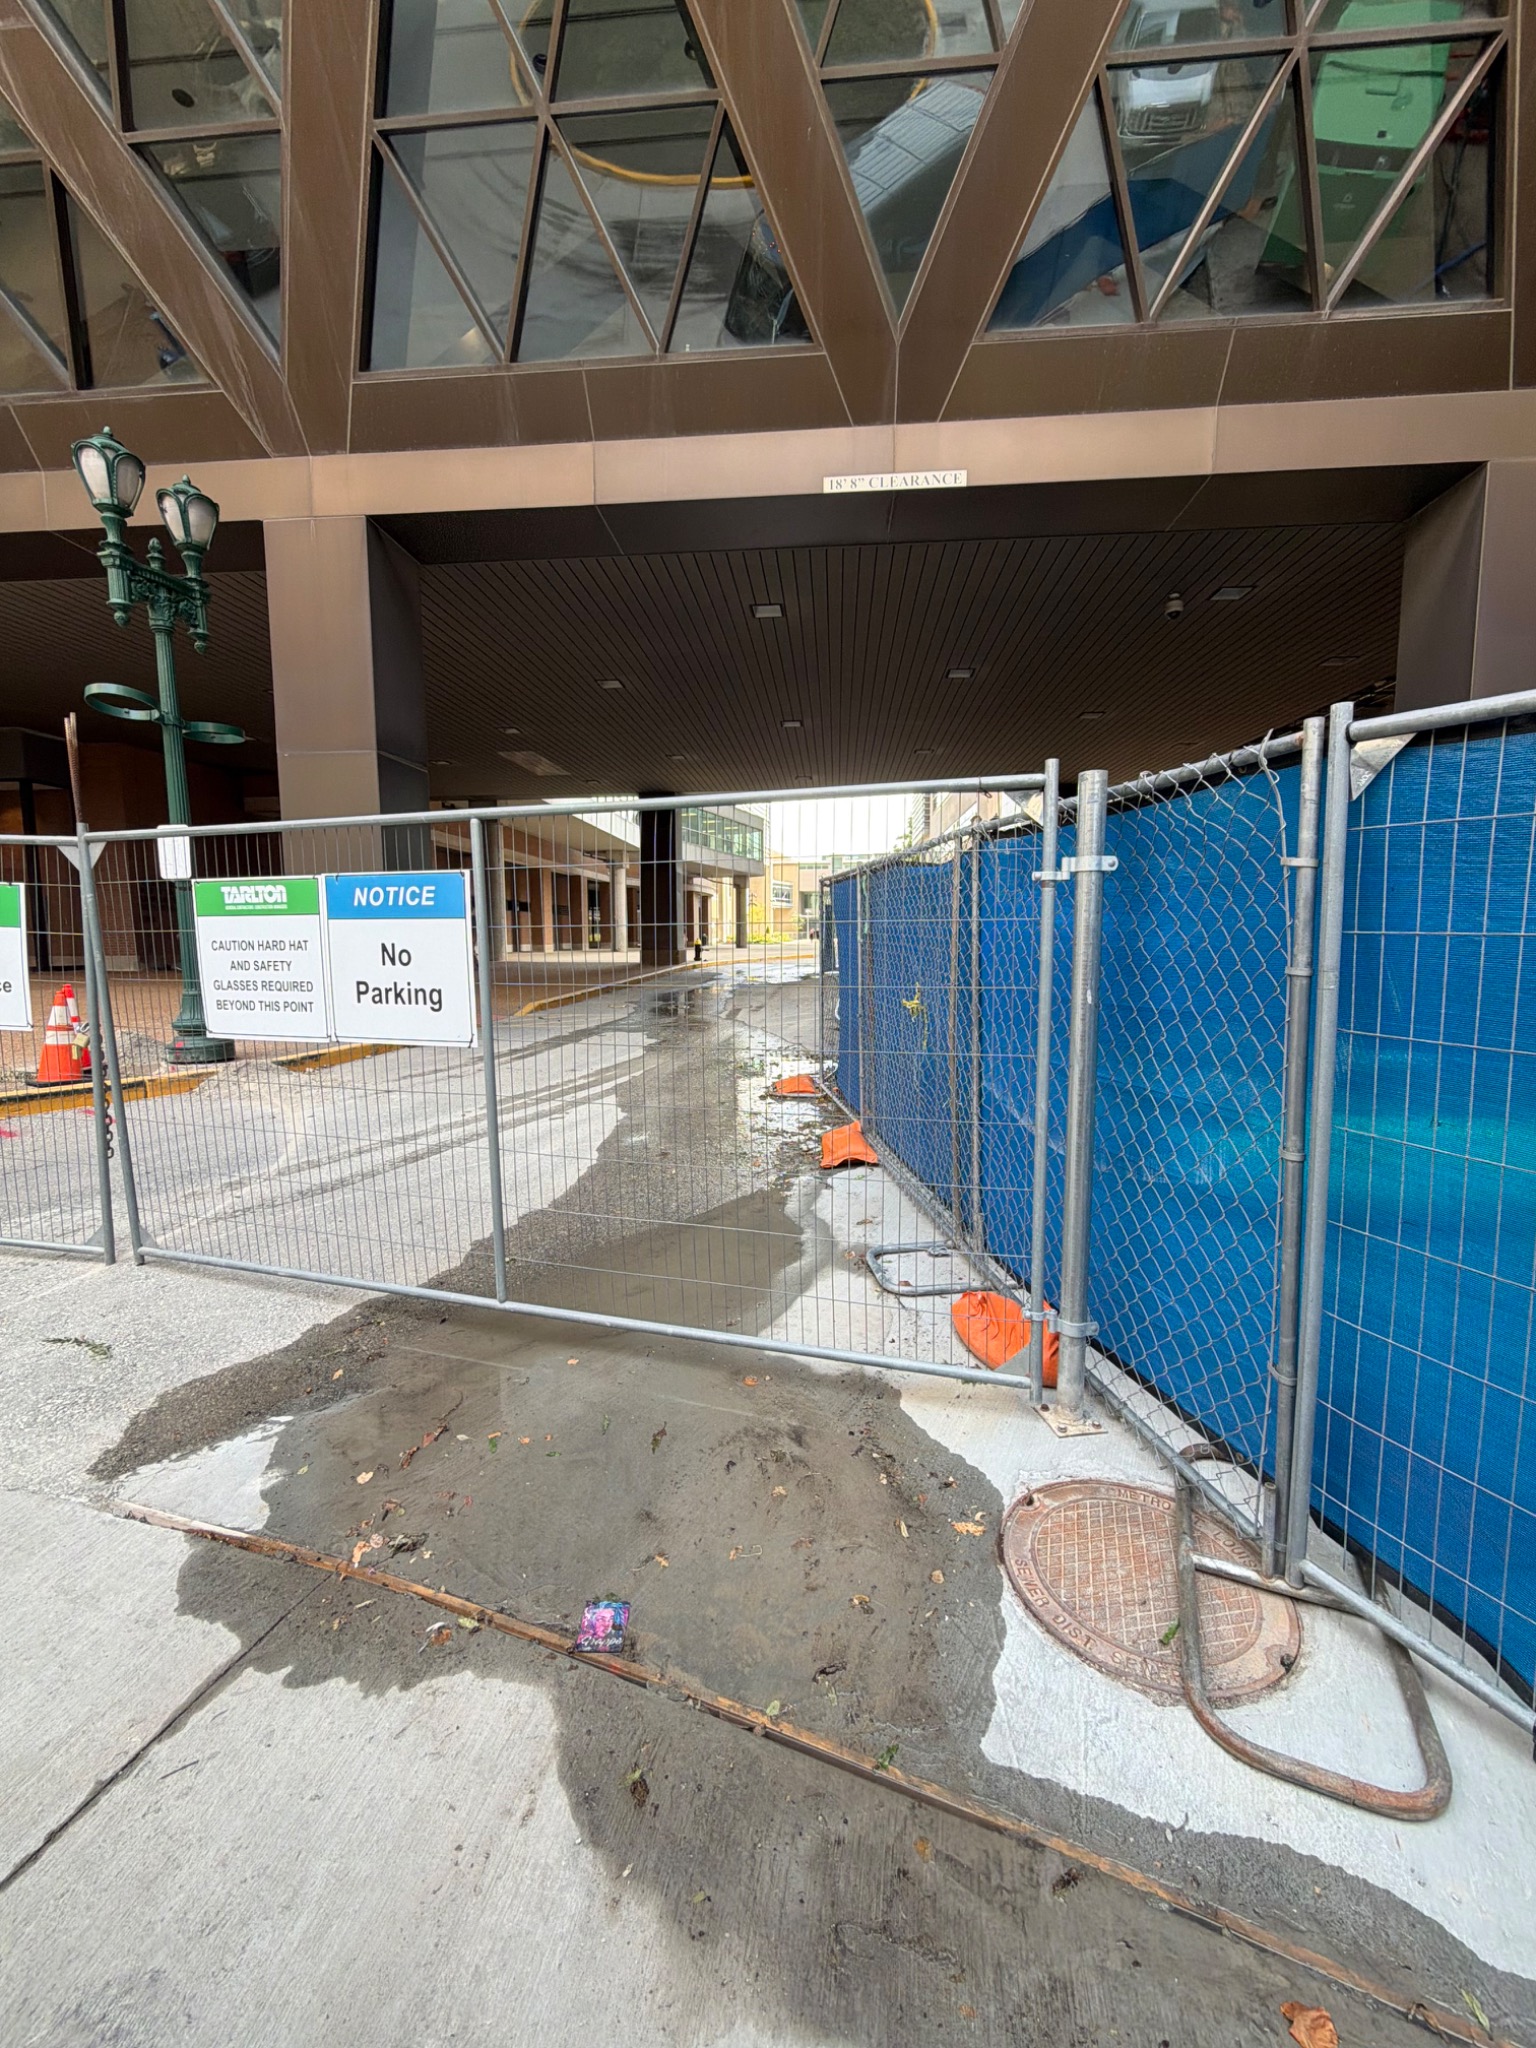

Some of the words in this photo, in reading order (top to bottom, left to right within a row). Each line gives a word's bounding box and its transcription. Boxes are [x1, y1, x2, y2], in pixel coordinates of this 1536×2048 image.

[869, 472, 963, 489] CLEARANCE
[220, 885, 288, 904] TARLTON
[353, 885, 436, 906] NOTICE
[211, 940, 255, 951] CAUTION
[257, 940, 286, 951] HARD
[289, 940, 309, 951] HAT
[381, 942, 412, 967] No
[230, 960, 251, 971] AND
[253, 960, 292, 971] SAFETY
[213, 980, 258, 991] GLASSES
[261, 981, 314, 992] REQUIRED
[216, 999, 256, 1011] BEYOND
[258, 1000, 280, 1012] THIS
[283, 1001, 314, 1012] POINT
[356, 980, 443, 1012] Parking
[1118, 1489, 1171, 1510] METRO
[1213, 1530, 1258, 1569] LOUIS
[1014, 1558, 1050, 1608] SEWER
